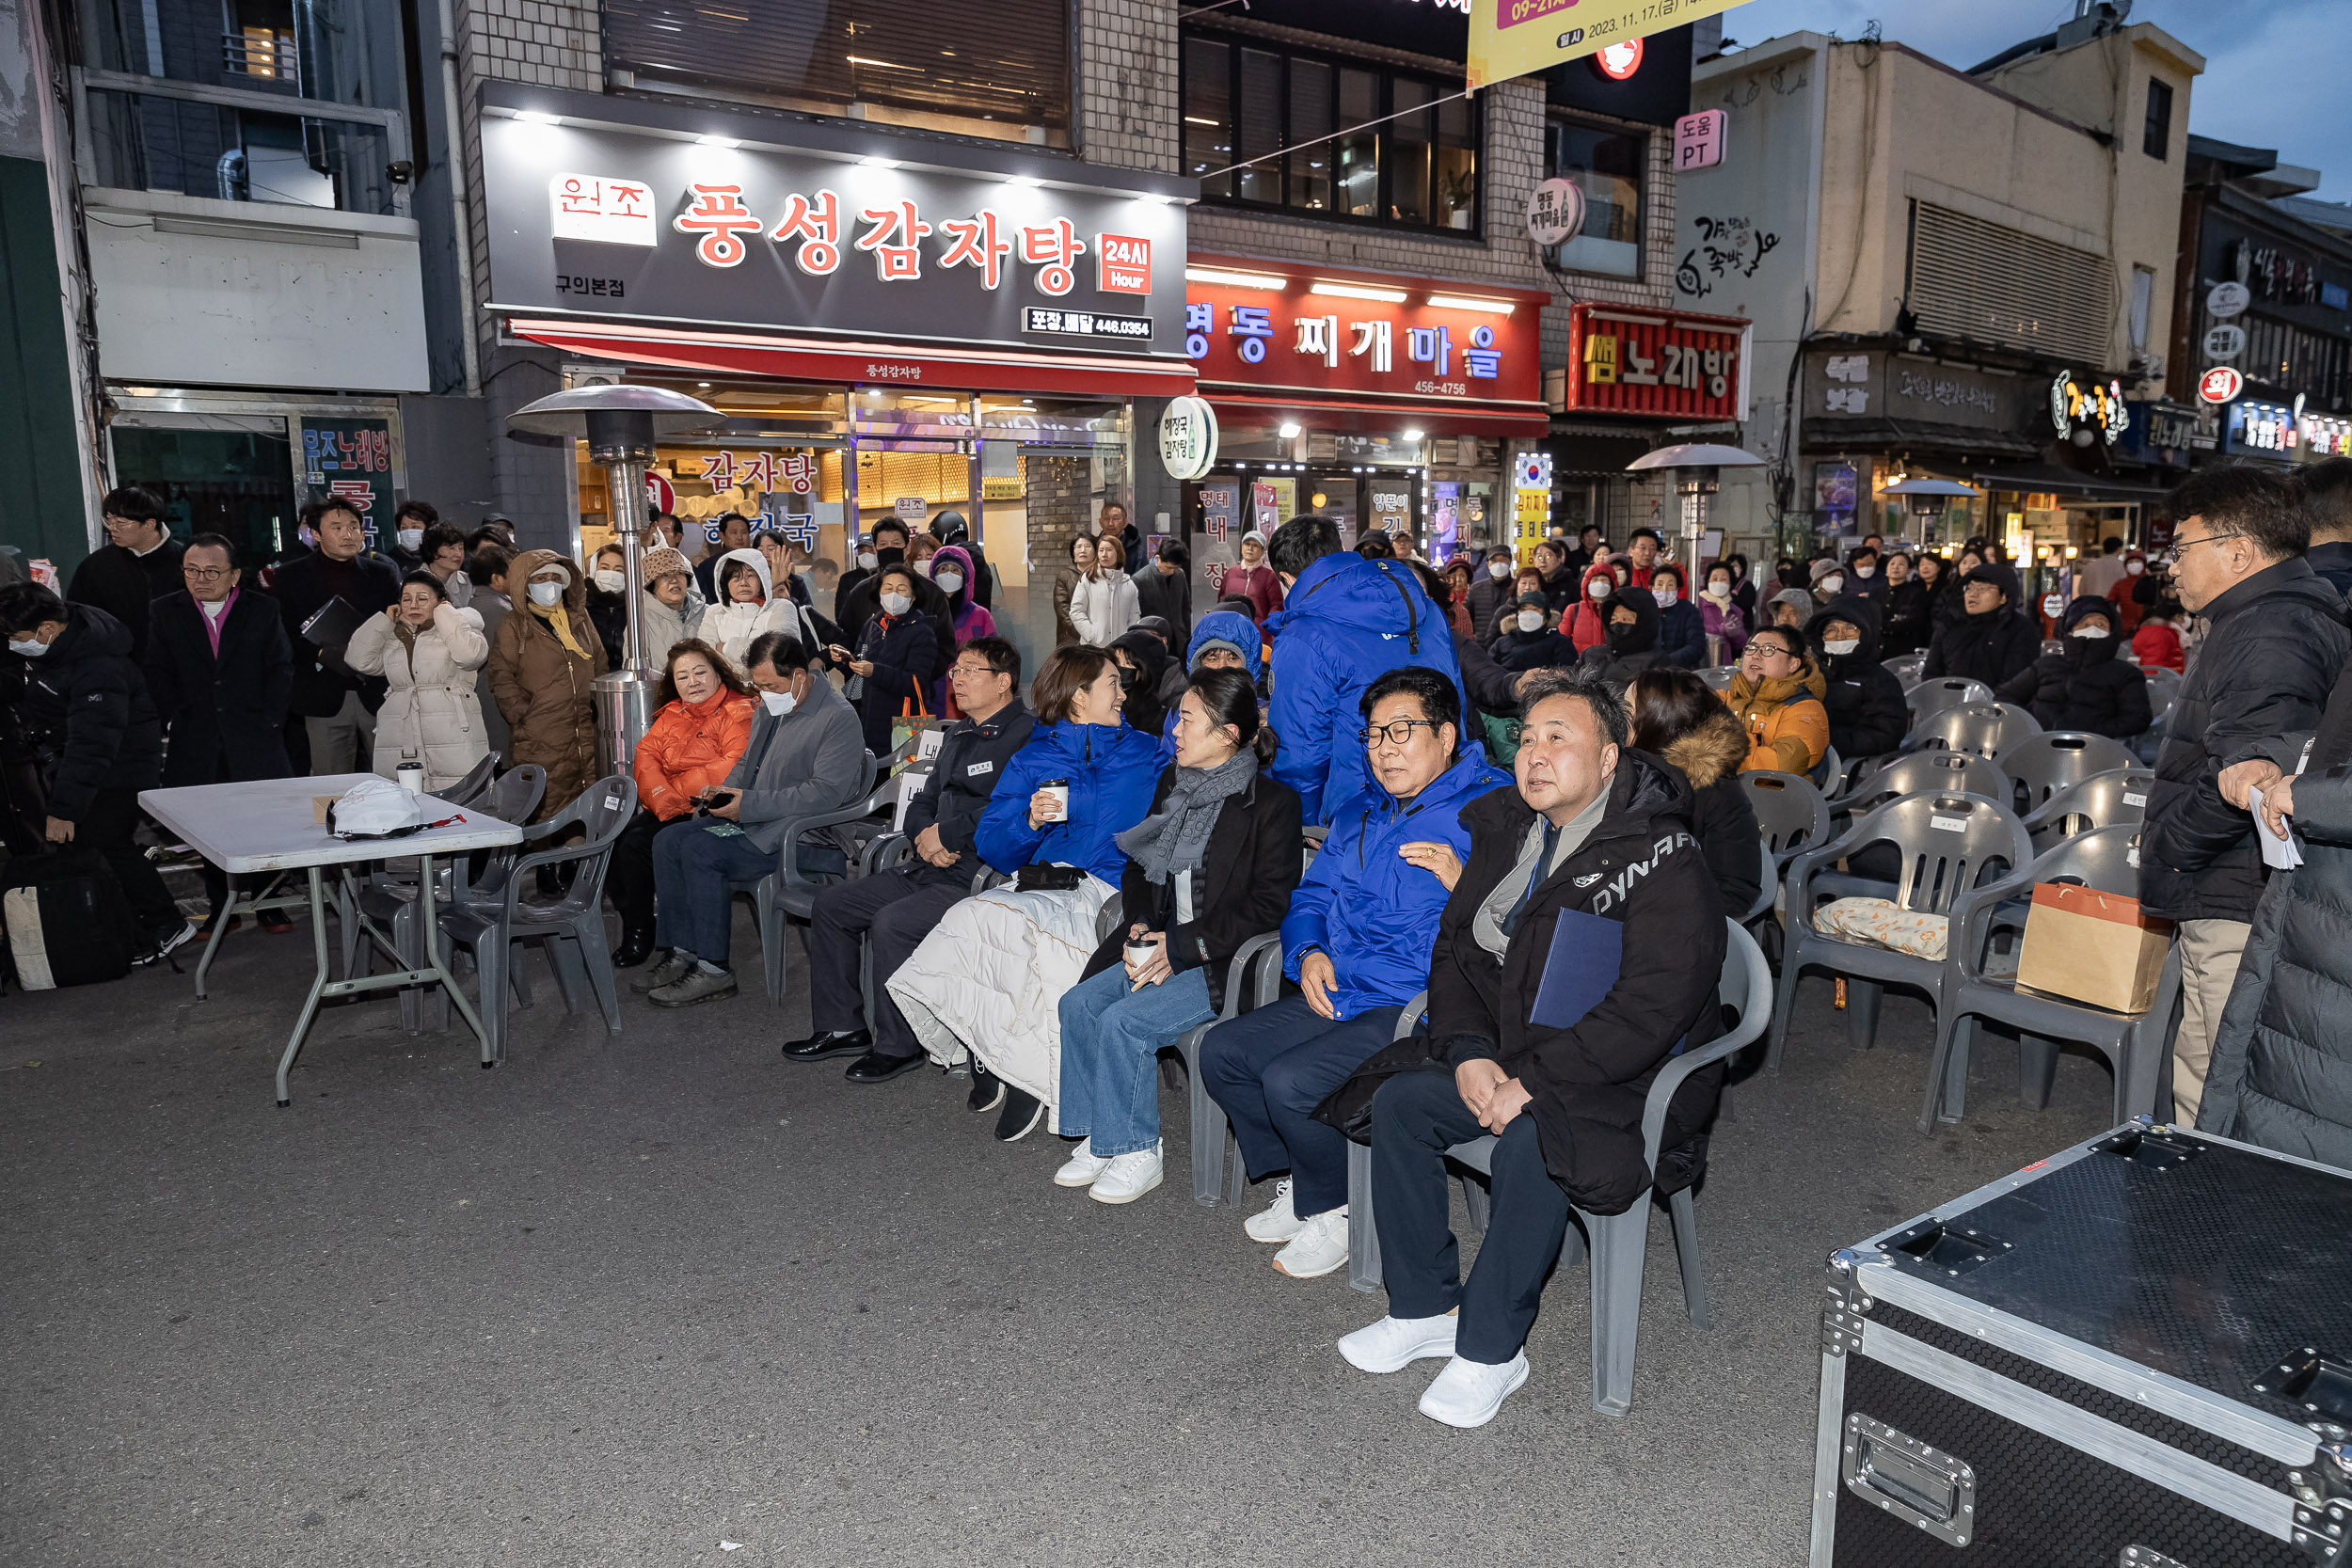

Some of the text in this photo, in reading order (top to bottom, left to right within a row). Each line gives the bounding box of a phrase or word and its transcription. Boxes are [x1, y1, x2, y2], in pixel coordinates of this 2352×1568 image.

[1560, 30, 1581, 46] 일시
[1588, 18, 1617, 39] 2023.
[1622, 14, 1638, 27] 11.
[1681, 116, 1711, 138] 도움
[1682, 143, 1708, 166] PT
[560, 179, 648, 218] 원조
[1537, 190, 1554, 211] 명동
[1531, 208, 1560, 231] 찌개마을
[673, 182, 1088, 297] 풍성감자탕
[1104, 240, 1148, 266] 24시
[1703, 245, 1743, 278] 족발
[556, 275, 626, 298] 구의본점
[1110, 271, 1145, 290] Hour
[1095, 319, 1150, 336] 446.0354
[866, 364, 922, 380] 풍성감자탕
[1414, 381, 1467, 396] 456-4756
[2204, 372, 2233, 398] 회
[1164, 416, 1187, 436] 해장국
[1165, 439, 1187, 460] 감자탕
[700, 450, 818, 495] 감자탕
[898, 499, 924, 511] 원조
[1199, 490, 1230, 508] 명태
[1592, 832, 1702, 916] DYNAF
